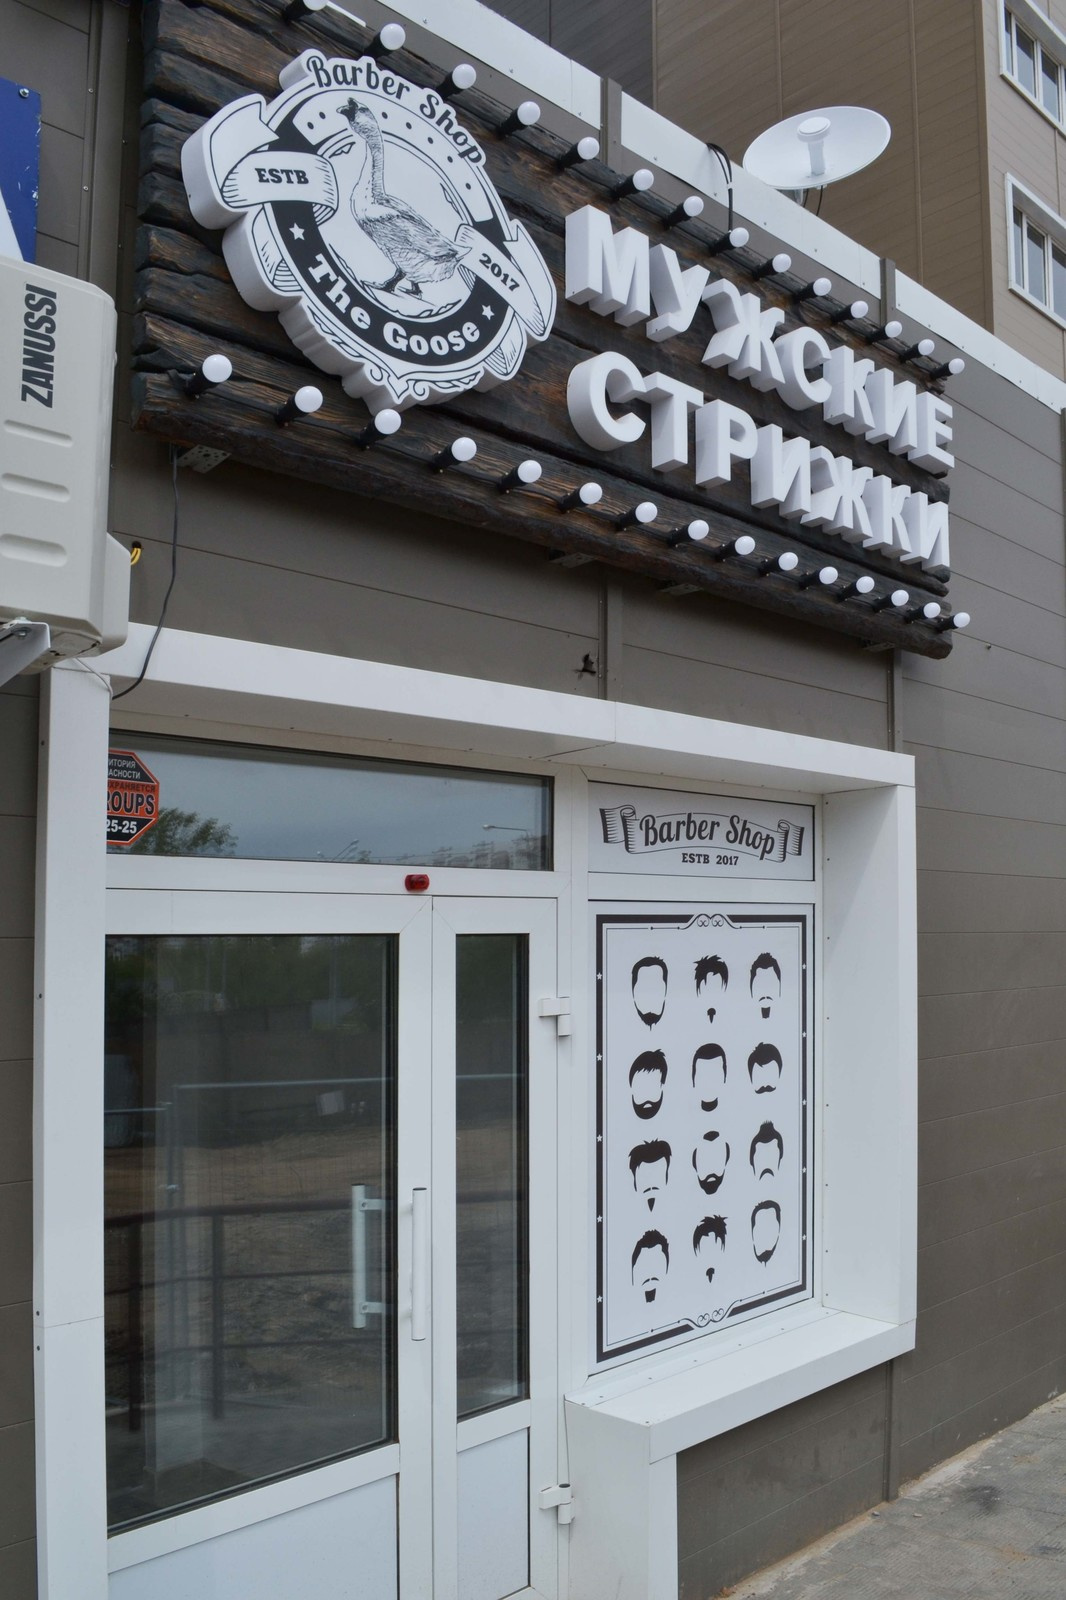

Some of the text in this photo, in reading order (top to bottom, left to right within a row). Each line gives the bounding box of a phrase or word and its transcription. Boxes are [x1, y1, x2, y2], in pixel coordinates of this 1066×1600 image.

[306, 55, 484, 165] Barber Shop
[254, 167, 310, 185] ESTB
[308, 253, 481, 357] The Goose
[478, 253, 521, 293] 2017
[21, 283, 57, 409] ZANUSSI
[565, 204, 955, 475] МУЖСКИЕ
[566, 351, 951, 573] СТРИЖКИ
[108, 780, 156, 793] ХРАНЯЕТСЯ
[639, 812, 775, 861] Barber Shop
[681, 852, 739, 866] ESTB 2017
